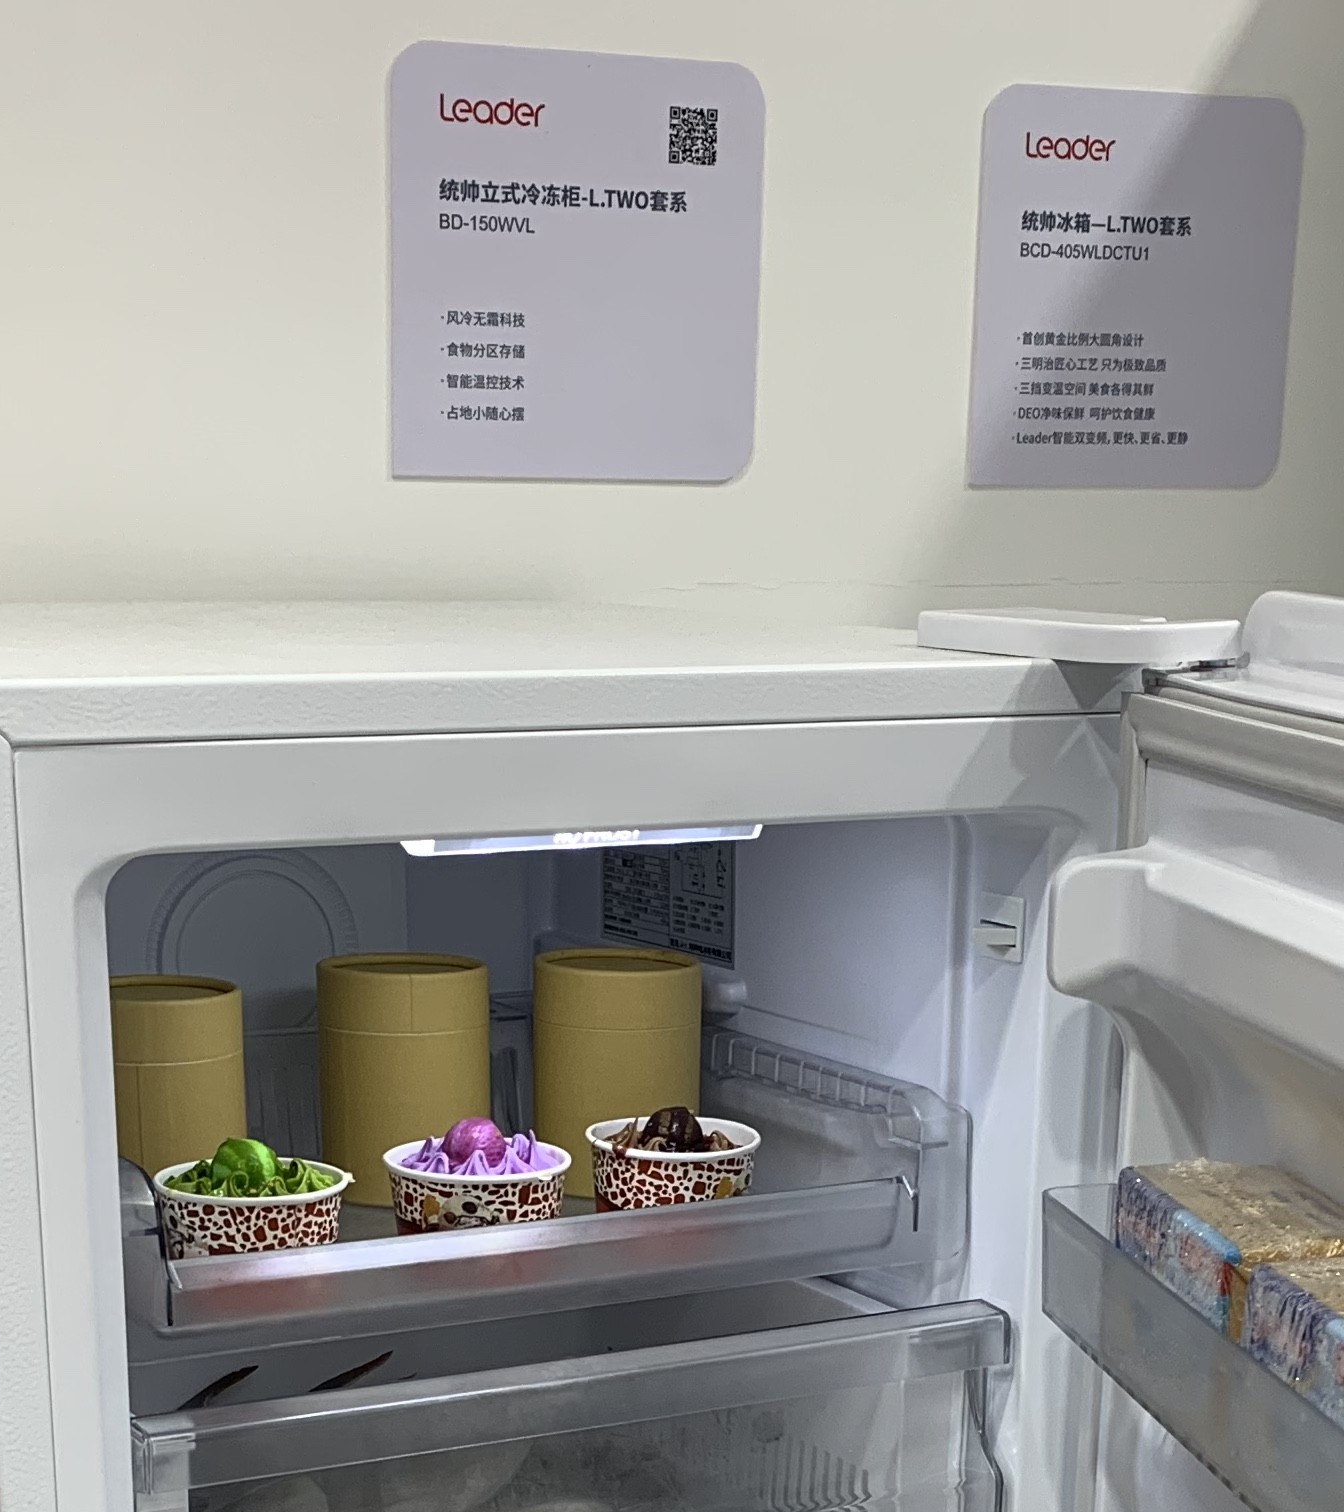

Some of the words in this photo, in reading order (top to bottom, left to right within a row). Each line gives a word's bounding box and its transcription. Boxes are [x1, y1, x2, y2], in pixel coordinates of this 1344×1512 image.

[439, 93, 546, 128] Leader
[1025, 131, 1117, 162] Leader
[438, 178, 688, 214] 统帅立式冷冻柜-L.TWO套系
[439, 213, 536, 234] BD-150WVL
[1019, 241, 1150, 262] BCD-405WLDCTU1
[446, 310, 526, 328] 风冷无霜科技
[446, 341, 526, 359] 食物分区存储
[446, 373, 526, 391] 智能温控技术
[446, 404, 525, 422] 占地小随心摆
